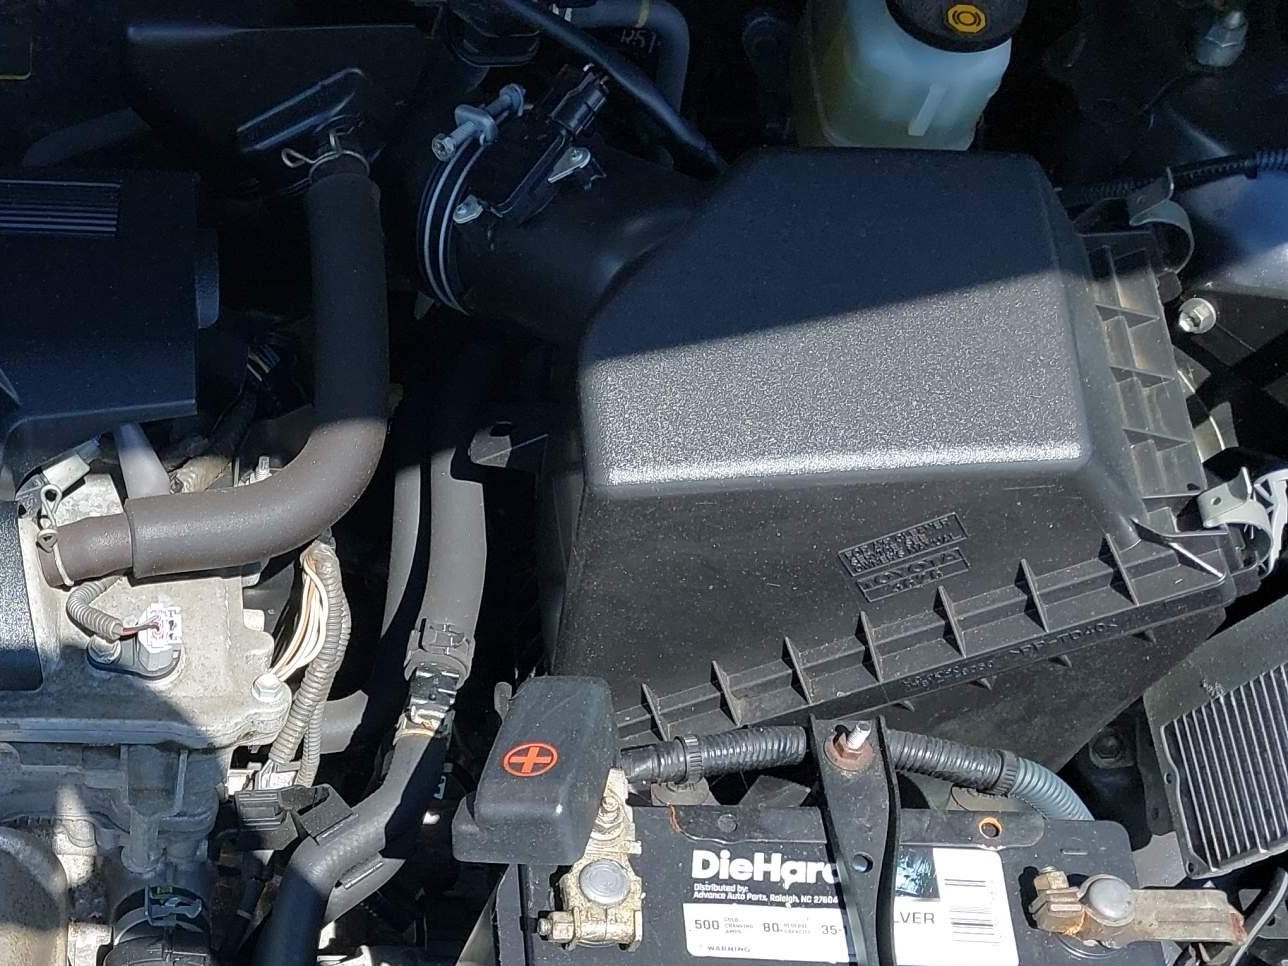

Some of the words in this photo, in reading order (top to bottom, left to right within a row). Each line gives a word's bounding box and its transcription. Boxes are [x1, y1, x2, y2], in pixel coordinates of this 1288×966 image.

[693, 883, 736, 892] Distributed
[693, 892, 726, 900] Advance
[727, 892, 745, 901] Auto
[801, 895, 812, 903] NC
[694, 919, 720, 931] 500
[763, 922, 780, 933] 80
